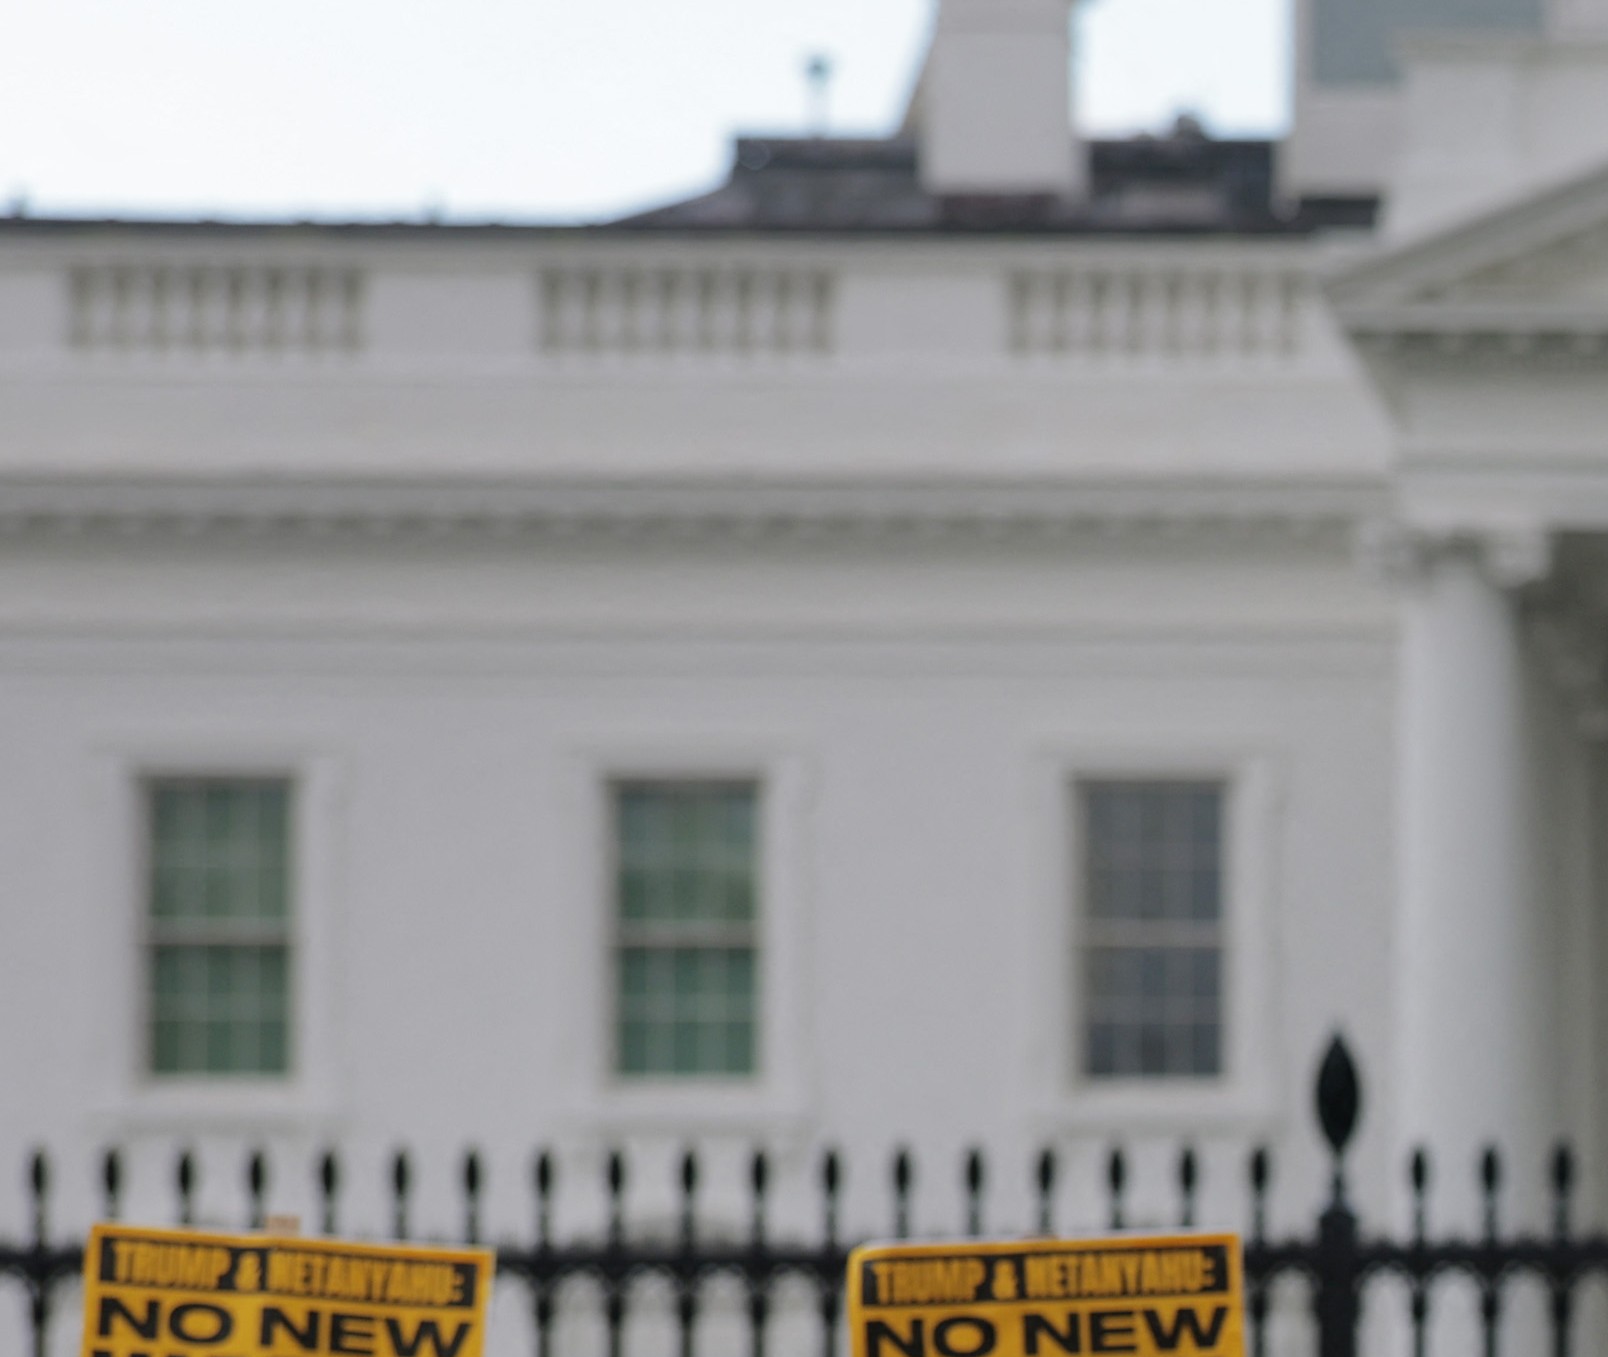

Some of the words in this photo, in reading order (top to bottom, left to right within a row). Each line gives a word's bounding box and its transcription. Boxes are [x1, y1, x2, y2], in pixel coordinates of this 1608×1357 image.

[114, 1241, 230, 1288] TRUMP
[234, 1250, 262, 1290] &
[873, 1259, 985, 1304] TRUMP
[991, 1259, 1020, 1300] &
[100, 1297, 233, 1344] NO
[1023, 1305, 1228, 1357] NEW
